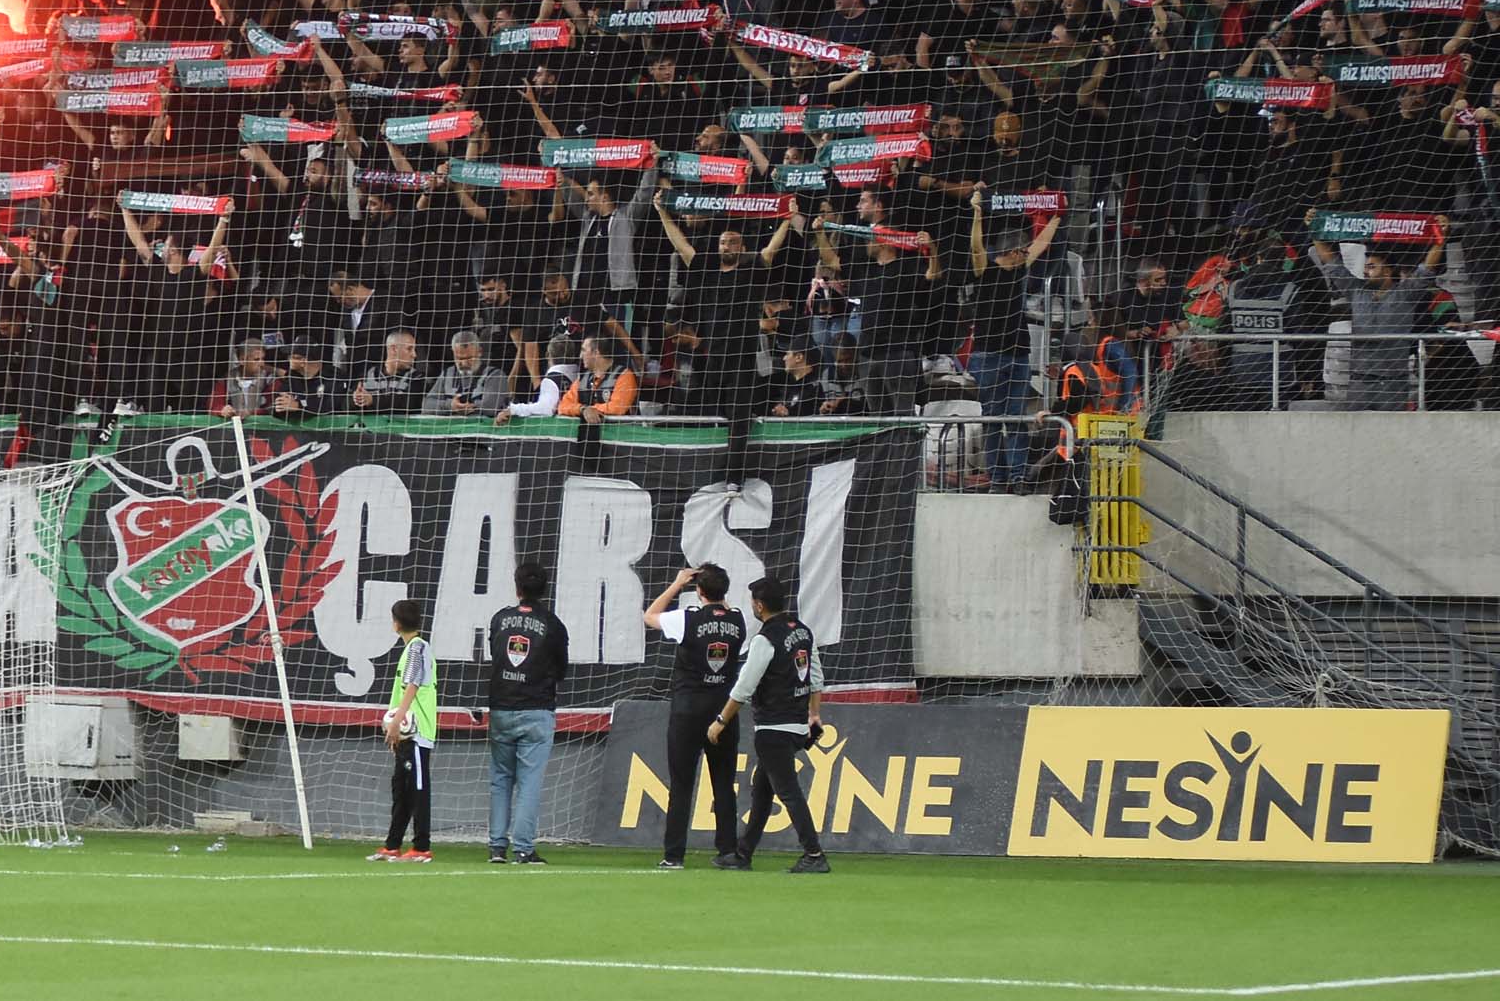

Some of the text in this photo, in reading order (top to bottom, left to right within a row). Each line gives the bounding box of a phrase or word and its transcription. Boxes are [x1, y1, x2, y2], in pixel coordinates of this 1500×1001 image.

[609, 9, 626, 25] BİZ
[1340, 63, 1358, 80] BİZ
[1216, 81, 1233, 97] BİZ
[819, 110, 835, 127] BİZ
[553, 147, 568, 164] BİZ
[1324, 216, 1341, 233] BİZ
[501, 616, 522, 631] SPOR
[697, 621, 718, 638] SPOR
